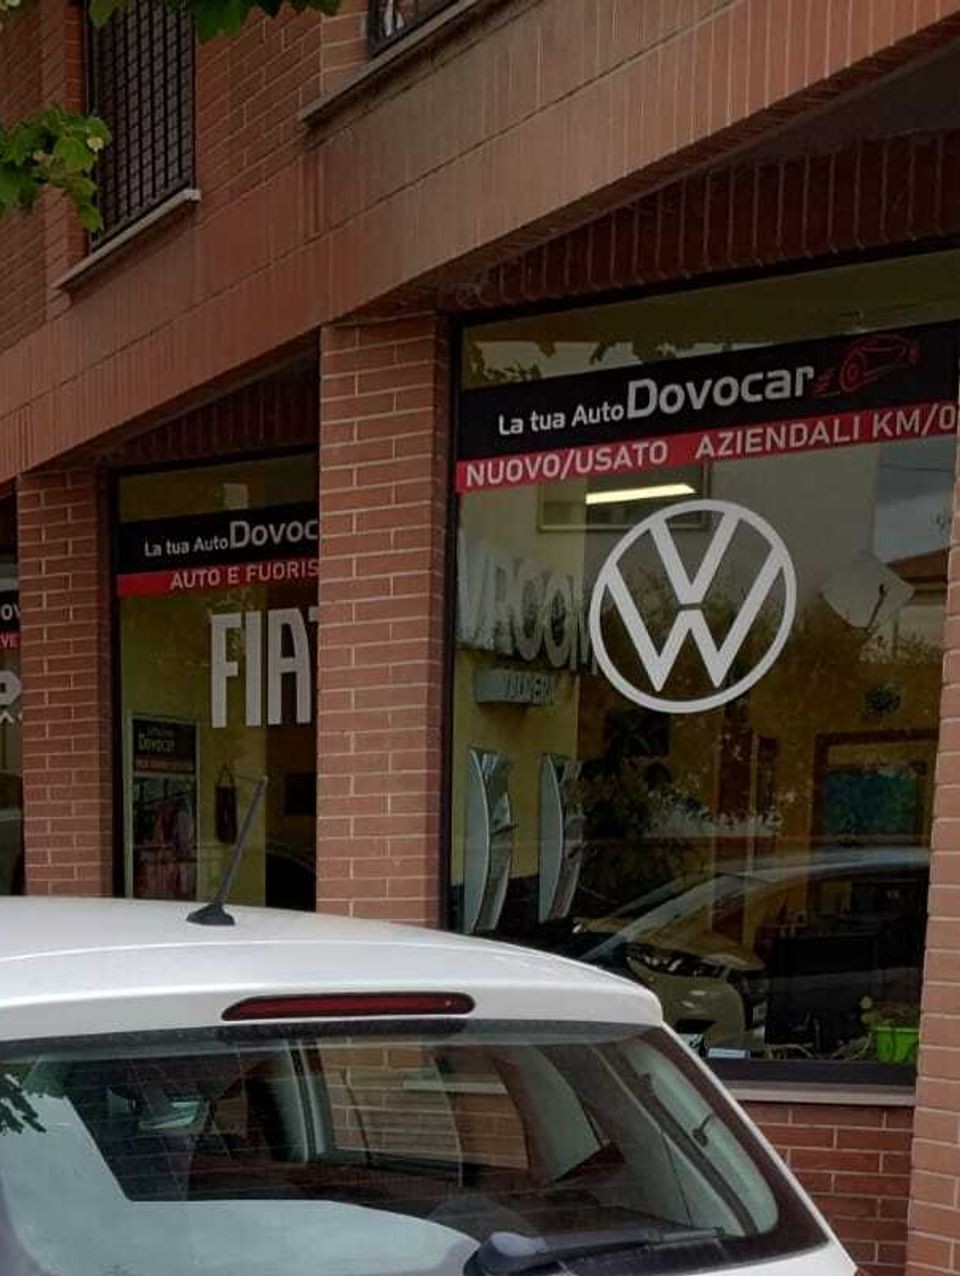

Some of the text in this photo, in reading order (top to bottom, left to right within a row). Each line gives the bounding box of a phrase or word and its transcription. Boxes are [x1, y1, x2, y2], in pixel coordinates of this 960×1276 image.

[499, 366, 815, 435] La tua Auto Dovocar
[465, 440, 668, 487] NUOVO/USATO
[695, 415, 860, 461] AZIENDALI
[144, 540, 162, 557] La
[166, 540, 189, 556] tua
[193, 535, 229, 552] Auto
[168, 568, 220, 591] AUTO
[227, 566, 239, 584] E
[211, 605, 319, 728] FIA
